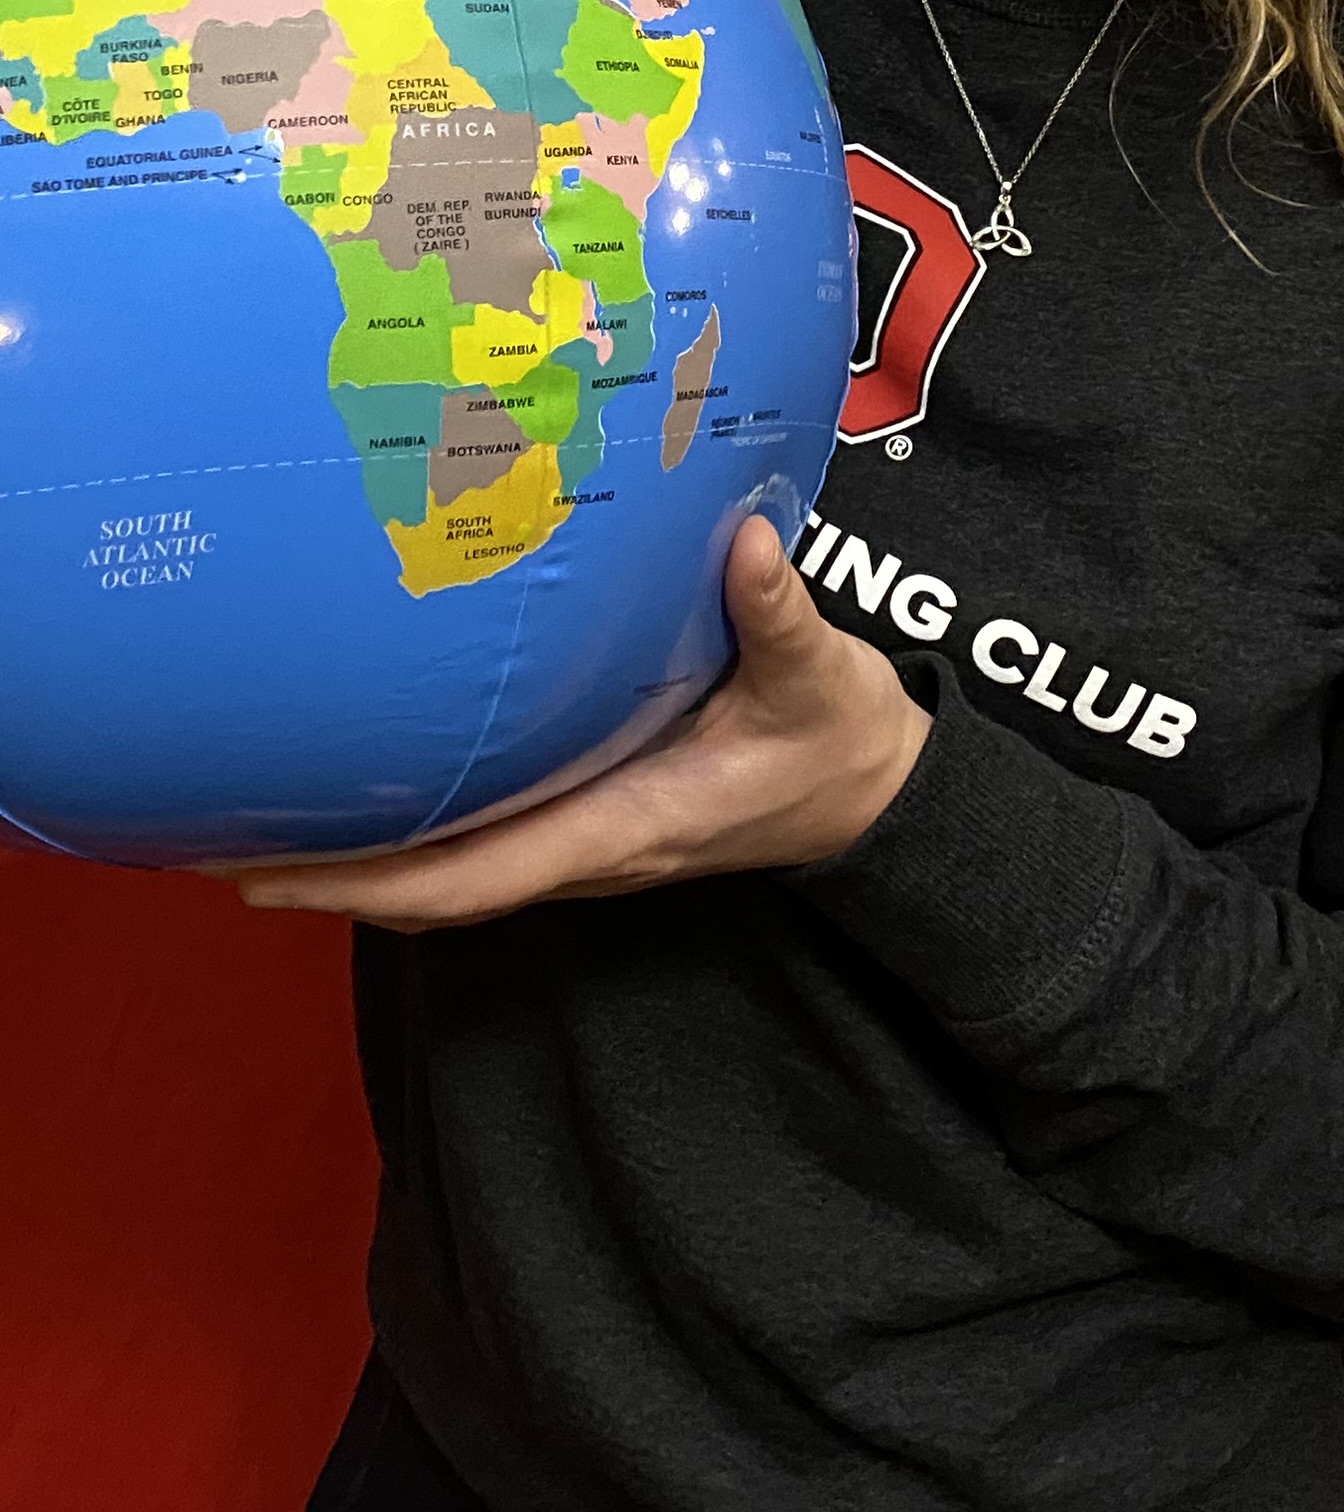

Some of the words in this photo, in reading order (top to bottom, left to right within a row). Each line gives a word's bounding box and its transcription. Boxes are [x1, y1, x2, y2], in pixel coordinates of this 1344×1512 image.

[465, 2, 510, 14] SUDAN
[100, 38, 163, 54] BURKINA
[112, 51, 149, 64] FASO
[663, 57, 700, 70] SOMALIA
[160, 62, 204, 76] BENIN
[595, 60, 640, 73] ETHIOPIA
[221, 70, 279, 86] NIGERIA
[387, 77, 449, 91] CENTRAL
[144, 88, 183, 101] TOGO
[389, 90, 448, 103] AFRICAN
[390, 101, 457, 115] REPUBLIC
[115, 113, 167, 128] GHANA
[268, 114, 349, 129] CAMEROON
[402, 121, 496, 140] AFRICA
[86, 150, 173, 170] EQUATORIAL
[179, 145, 233, 161] GUINEA
[544, 144, 593, 159] UGANDA
[606, 153, 640, 167] KENYA
[65, 176, 105, 190] TOME
[108, 174, 141, 187] AND
[142, 169, 208, 185] PRINCIPE
[284, 191, 336, 206] GABON
[342, 192, 393, 207] CONGO
[484, 190, 541, 203] RWANDA
[415, 215, 433, 227] OF
[437, 213, 464, 225] THE
[484, 207, 541, 221] BURUNDI
[416, 226, 466, 240] CONGO
[573, 240, 625, 254] TANZANIA
[665, 289, 707, 302] COMOROS
[367, 317, 425, 330] ANGOLA
[586, 318, 628, 331] MALAWI
[488, 343, 538, 358] ZAMBIA
[591, 371, 658, 389] MOZAMBIQUE
[676, 385, 729, 401] MADAGASCAR
[466, 396, 535, 412] ZIMBABWE
[369, 435, 426, 449] NAMIBIA
[447, 442, 522, 458] BOTSWANA
[553, 490, 615, 507] SWAZILAND
[100, 510, 193, 541] SOUTH
[446, 515, 492, 530] SOUTH
[445, 527, 494, 541] AFRICA
[81, 533, 218, 568] ATLANTIC
[464, 542, 525, 561] LESOTHO
[101, 560, 195, 590] OCEAN
[799, 509, 958, 642] ING
[972, 619, 1196, 757] CLUB
